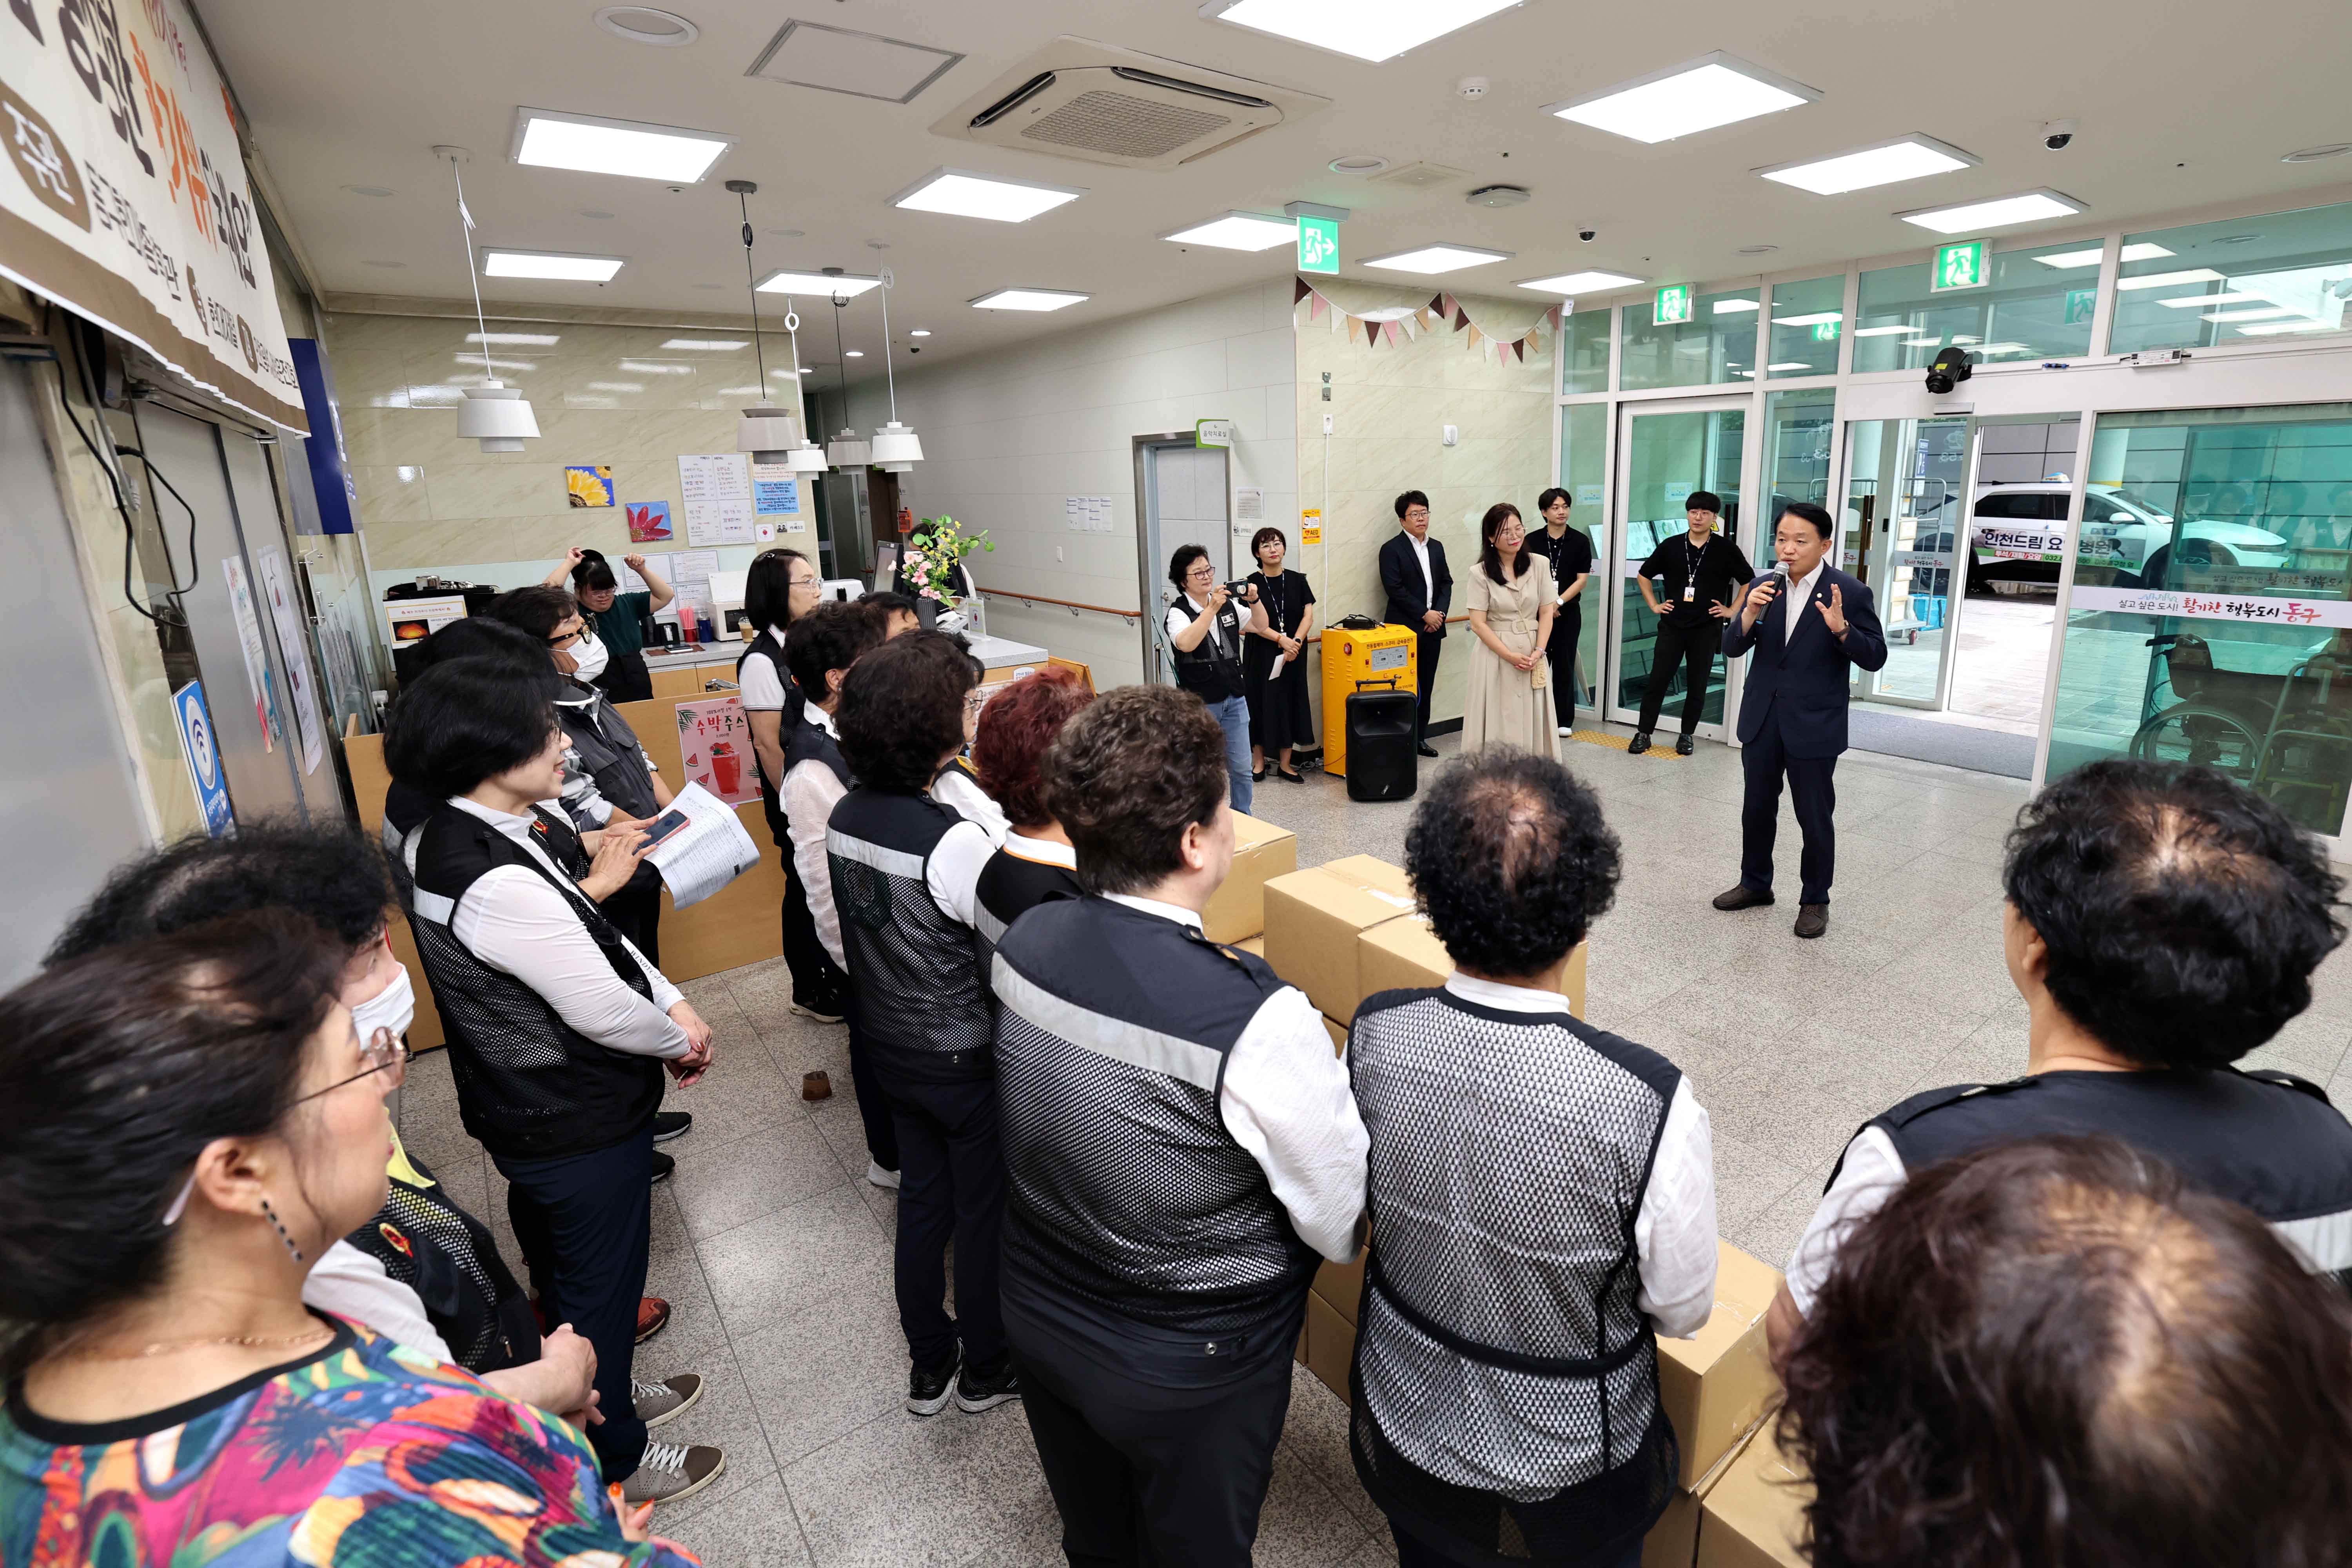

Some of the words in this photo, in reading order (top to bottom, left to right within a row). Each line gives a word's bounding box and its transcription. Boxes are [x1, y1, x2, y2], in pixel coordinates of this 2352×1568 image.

[129, 30, 218, 254] 한가위
[1985, 532, 2043, 550] 인천드림
[2119, 599, 2136, 608] 살고
[2138, 601, 2156, 610] 싶은
[2157, 602, 2178, 612] 도시!
[2182, 597, 2221, 613] 활기찬
[2226, 602, 2280, 618] 행복도시
[2282, 603, 2322, 623] 동구
[697, 715, 744, 736] 수박주스
